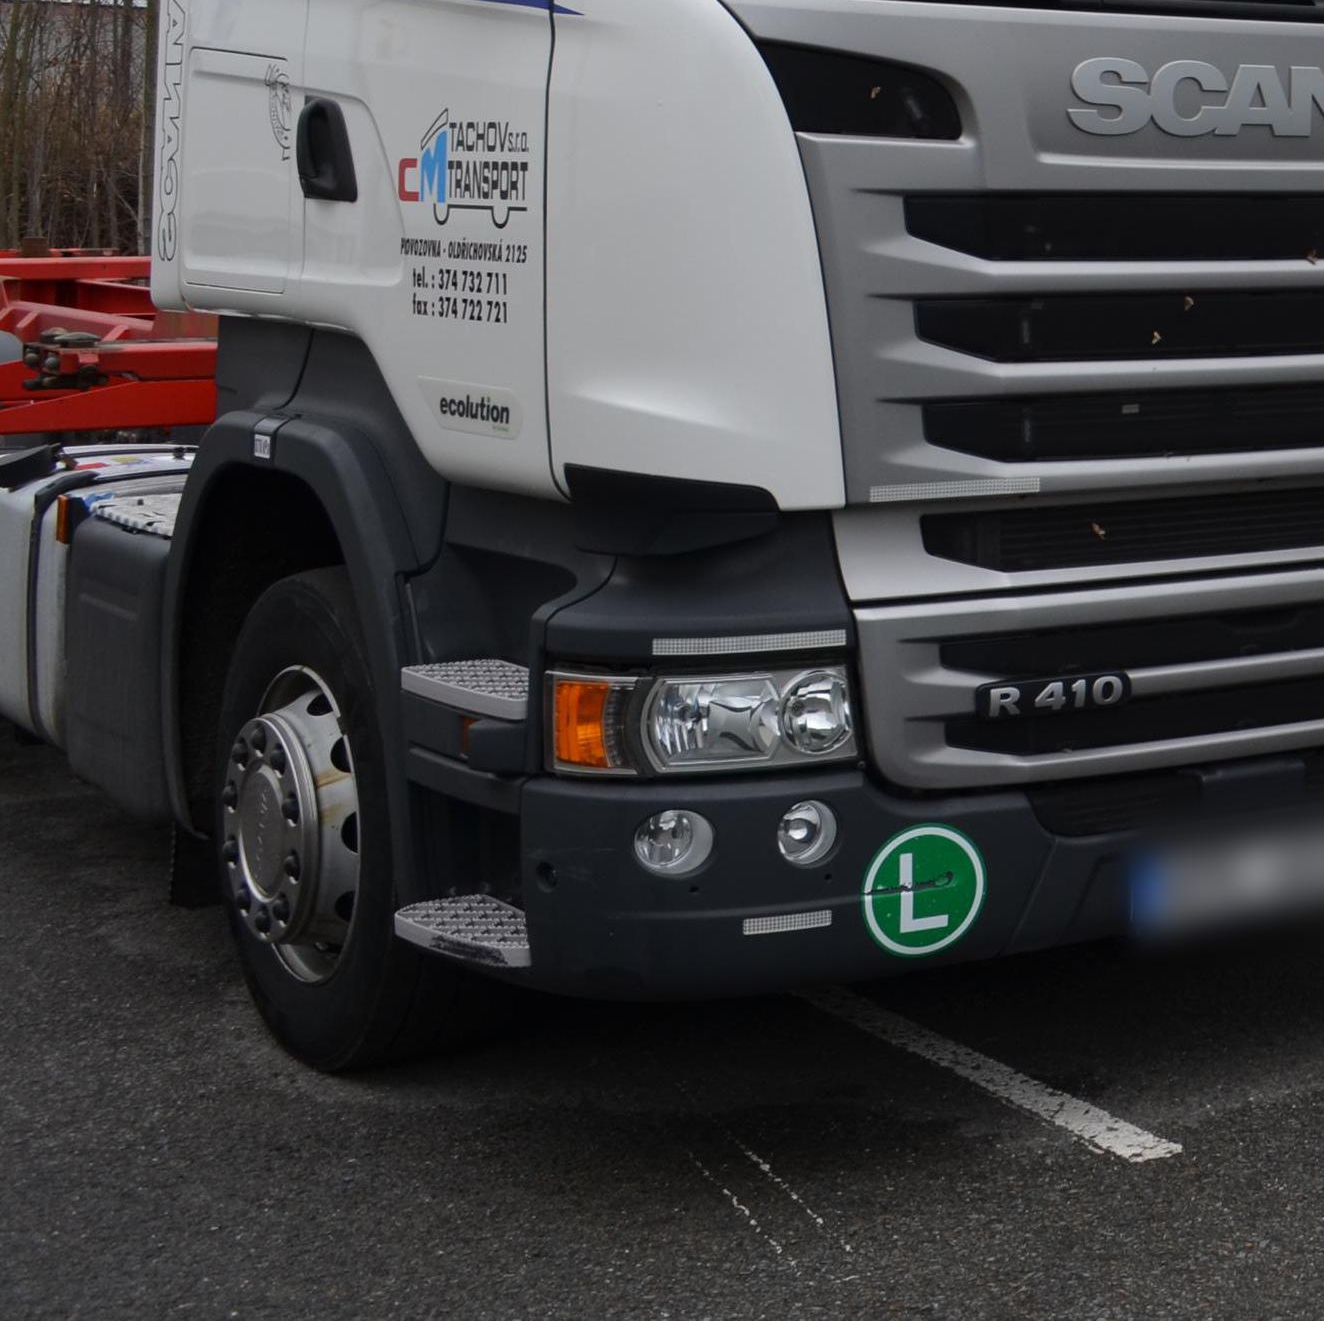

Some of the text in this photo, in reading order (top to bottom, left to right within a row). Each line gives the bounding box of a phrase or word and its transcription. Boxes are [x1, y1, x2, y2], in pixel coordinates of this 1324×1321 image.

[449, 121, 509, 153] TACHOV
[398, 130, 447, 203] CM
[448, 161, 529, 201] TRANSPORT
[505, 244, 527, 263] 2125
[413, 266, 428, 288] tel.
[439, 268, 458, 291] 374
[462, 270, 482, 293] 732
[487, 272, 507, 295] 711
[413, 292, 428, 316] fax
[439, 296, 458, 319] 374
[462, 298, 482, 321] 722
[487, 300, 507, 324] 721
[440, 394, 510, 424] ecolution
[989, 676, 1123, 717] R 410
[900, 853, 948, 933] L
